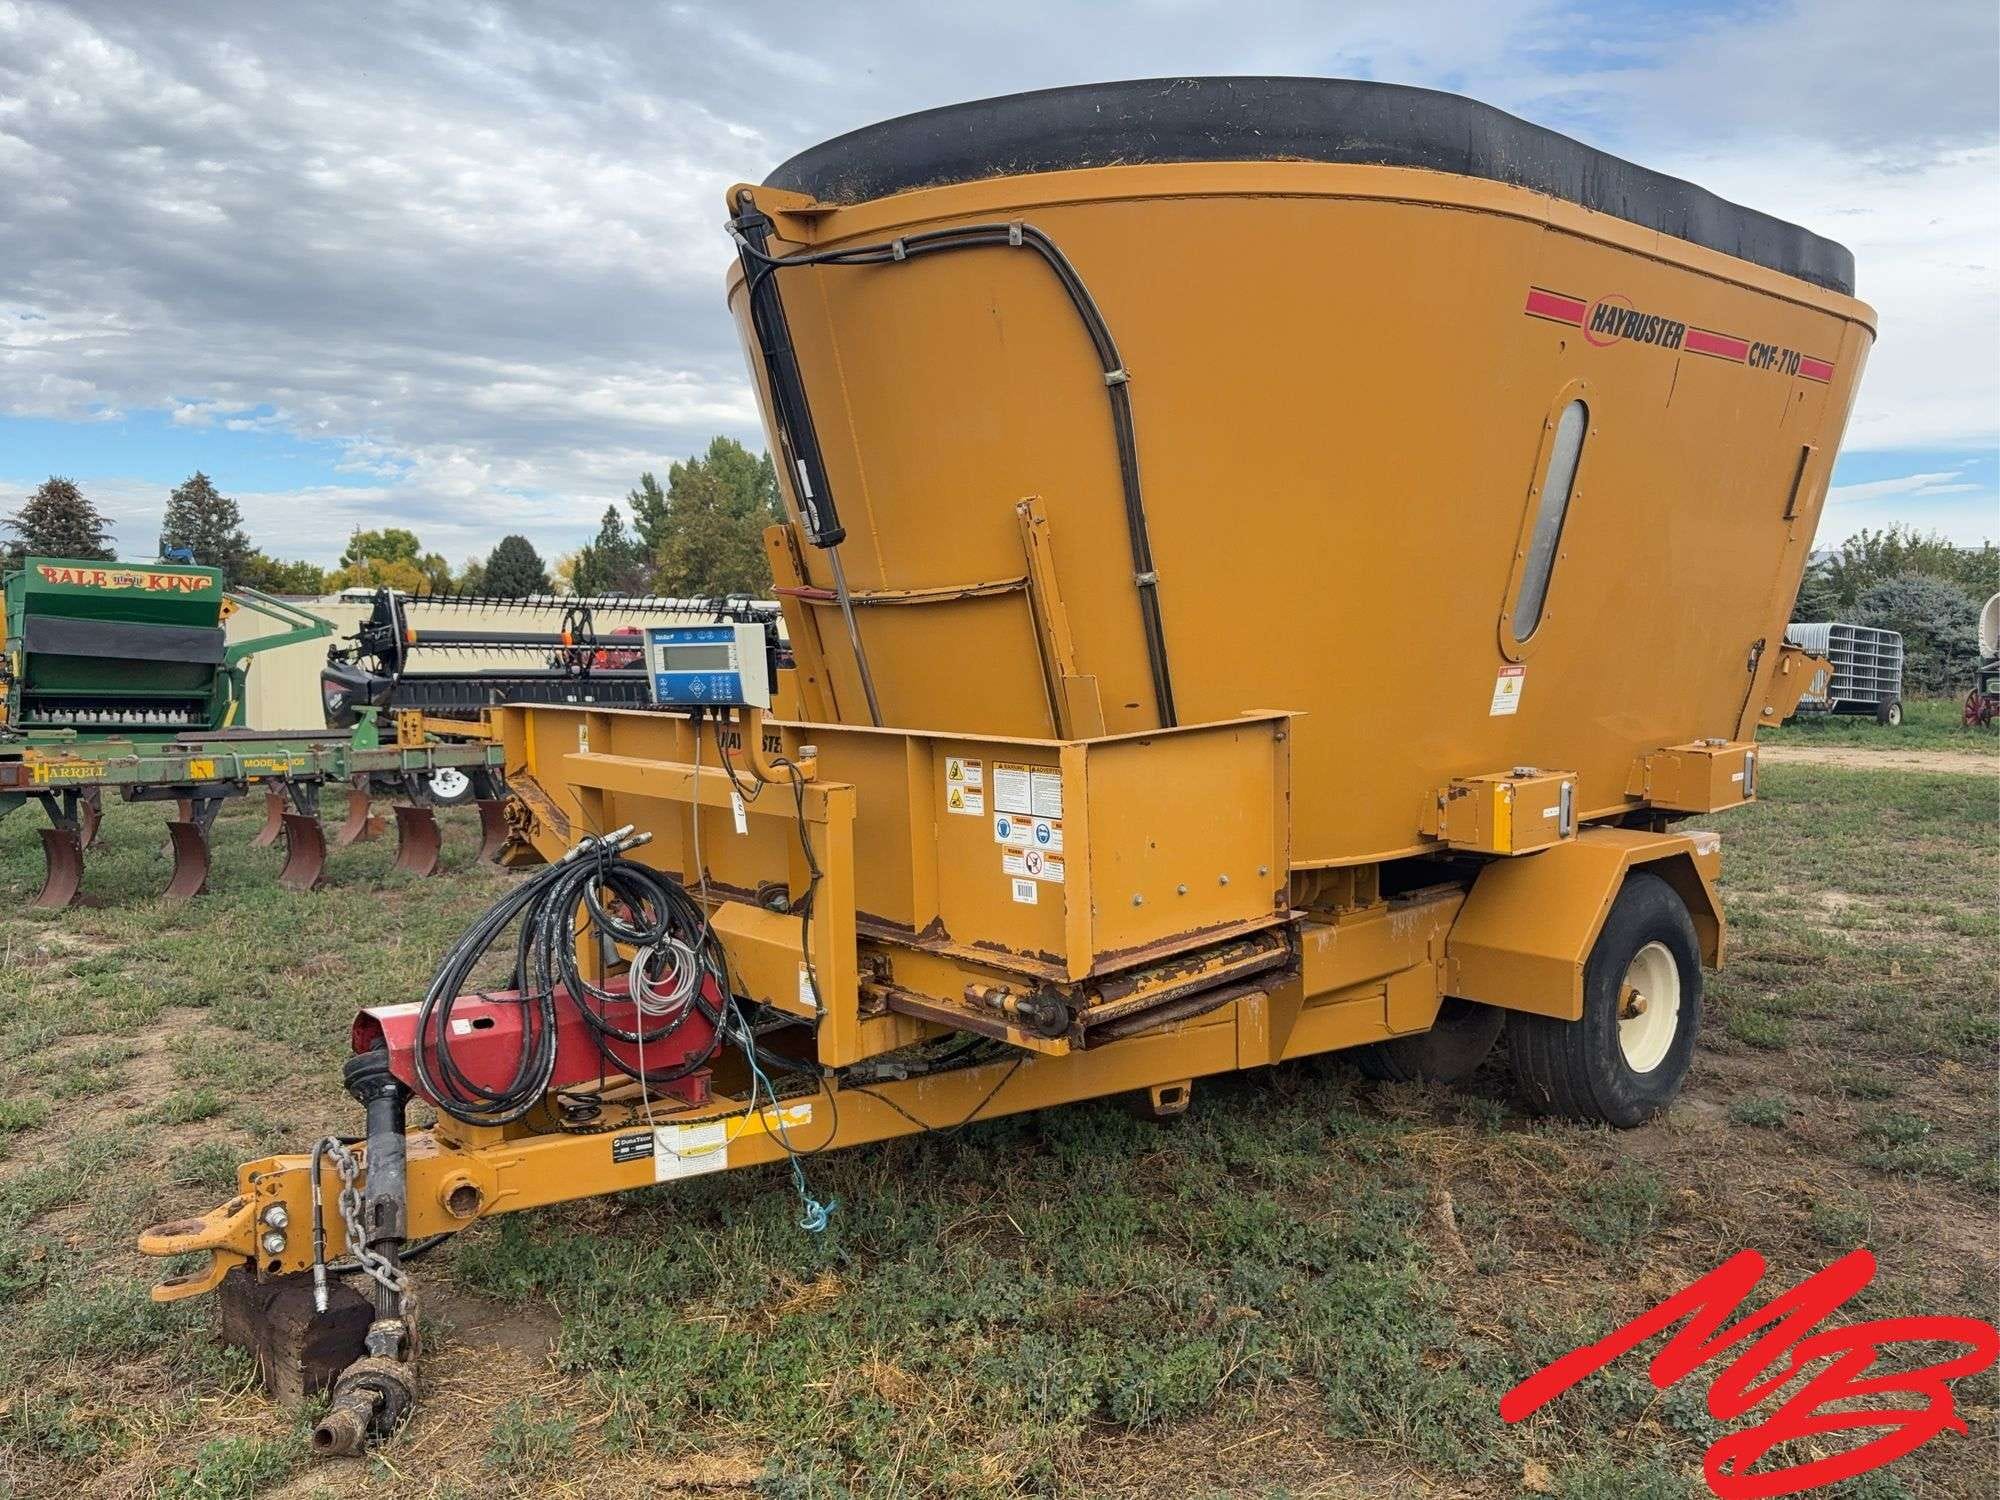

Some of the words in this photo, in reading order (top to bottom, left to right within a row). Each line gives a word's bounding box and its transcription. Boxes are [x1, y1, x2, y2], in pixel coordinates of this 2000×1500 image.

[1590, 303, 1686, 350] HAYBUSTER
[1749, 342, 1801, 376] CMF-710
[43, 567, 107, 586] BALE
[33, 762, 107, 783] HARRELL
[244, 758, 279, 768] MODEL
